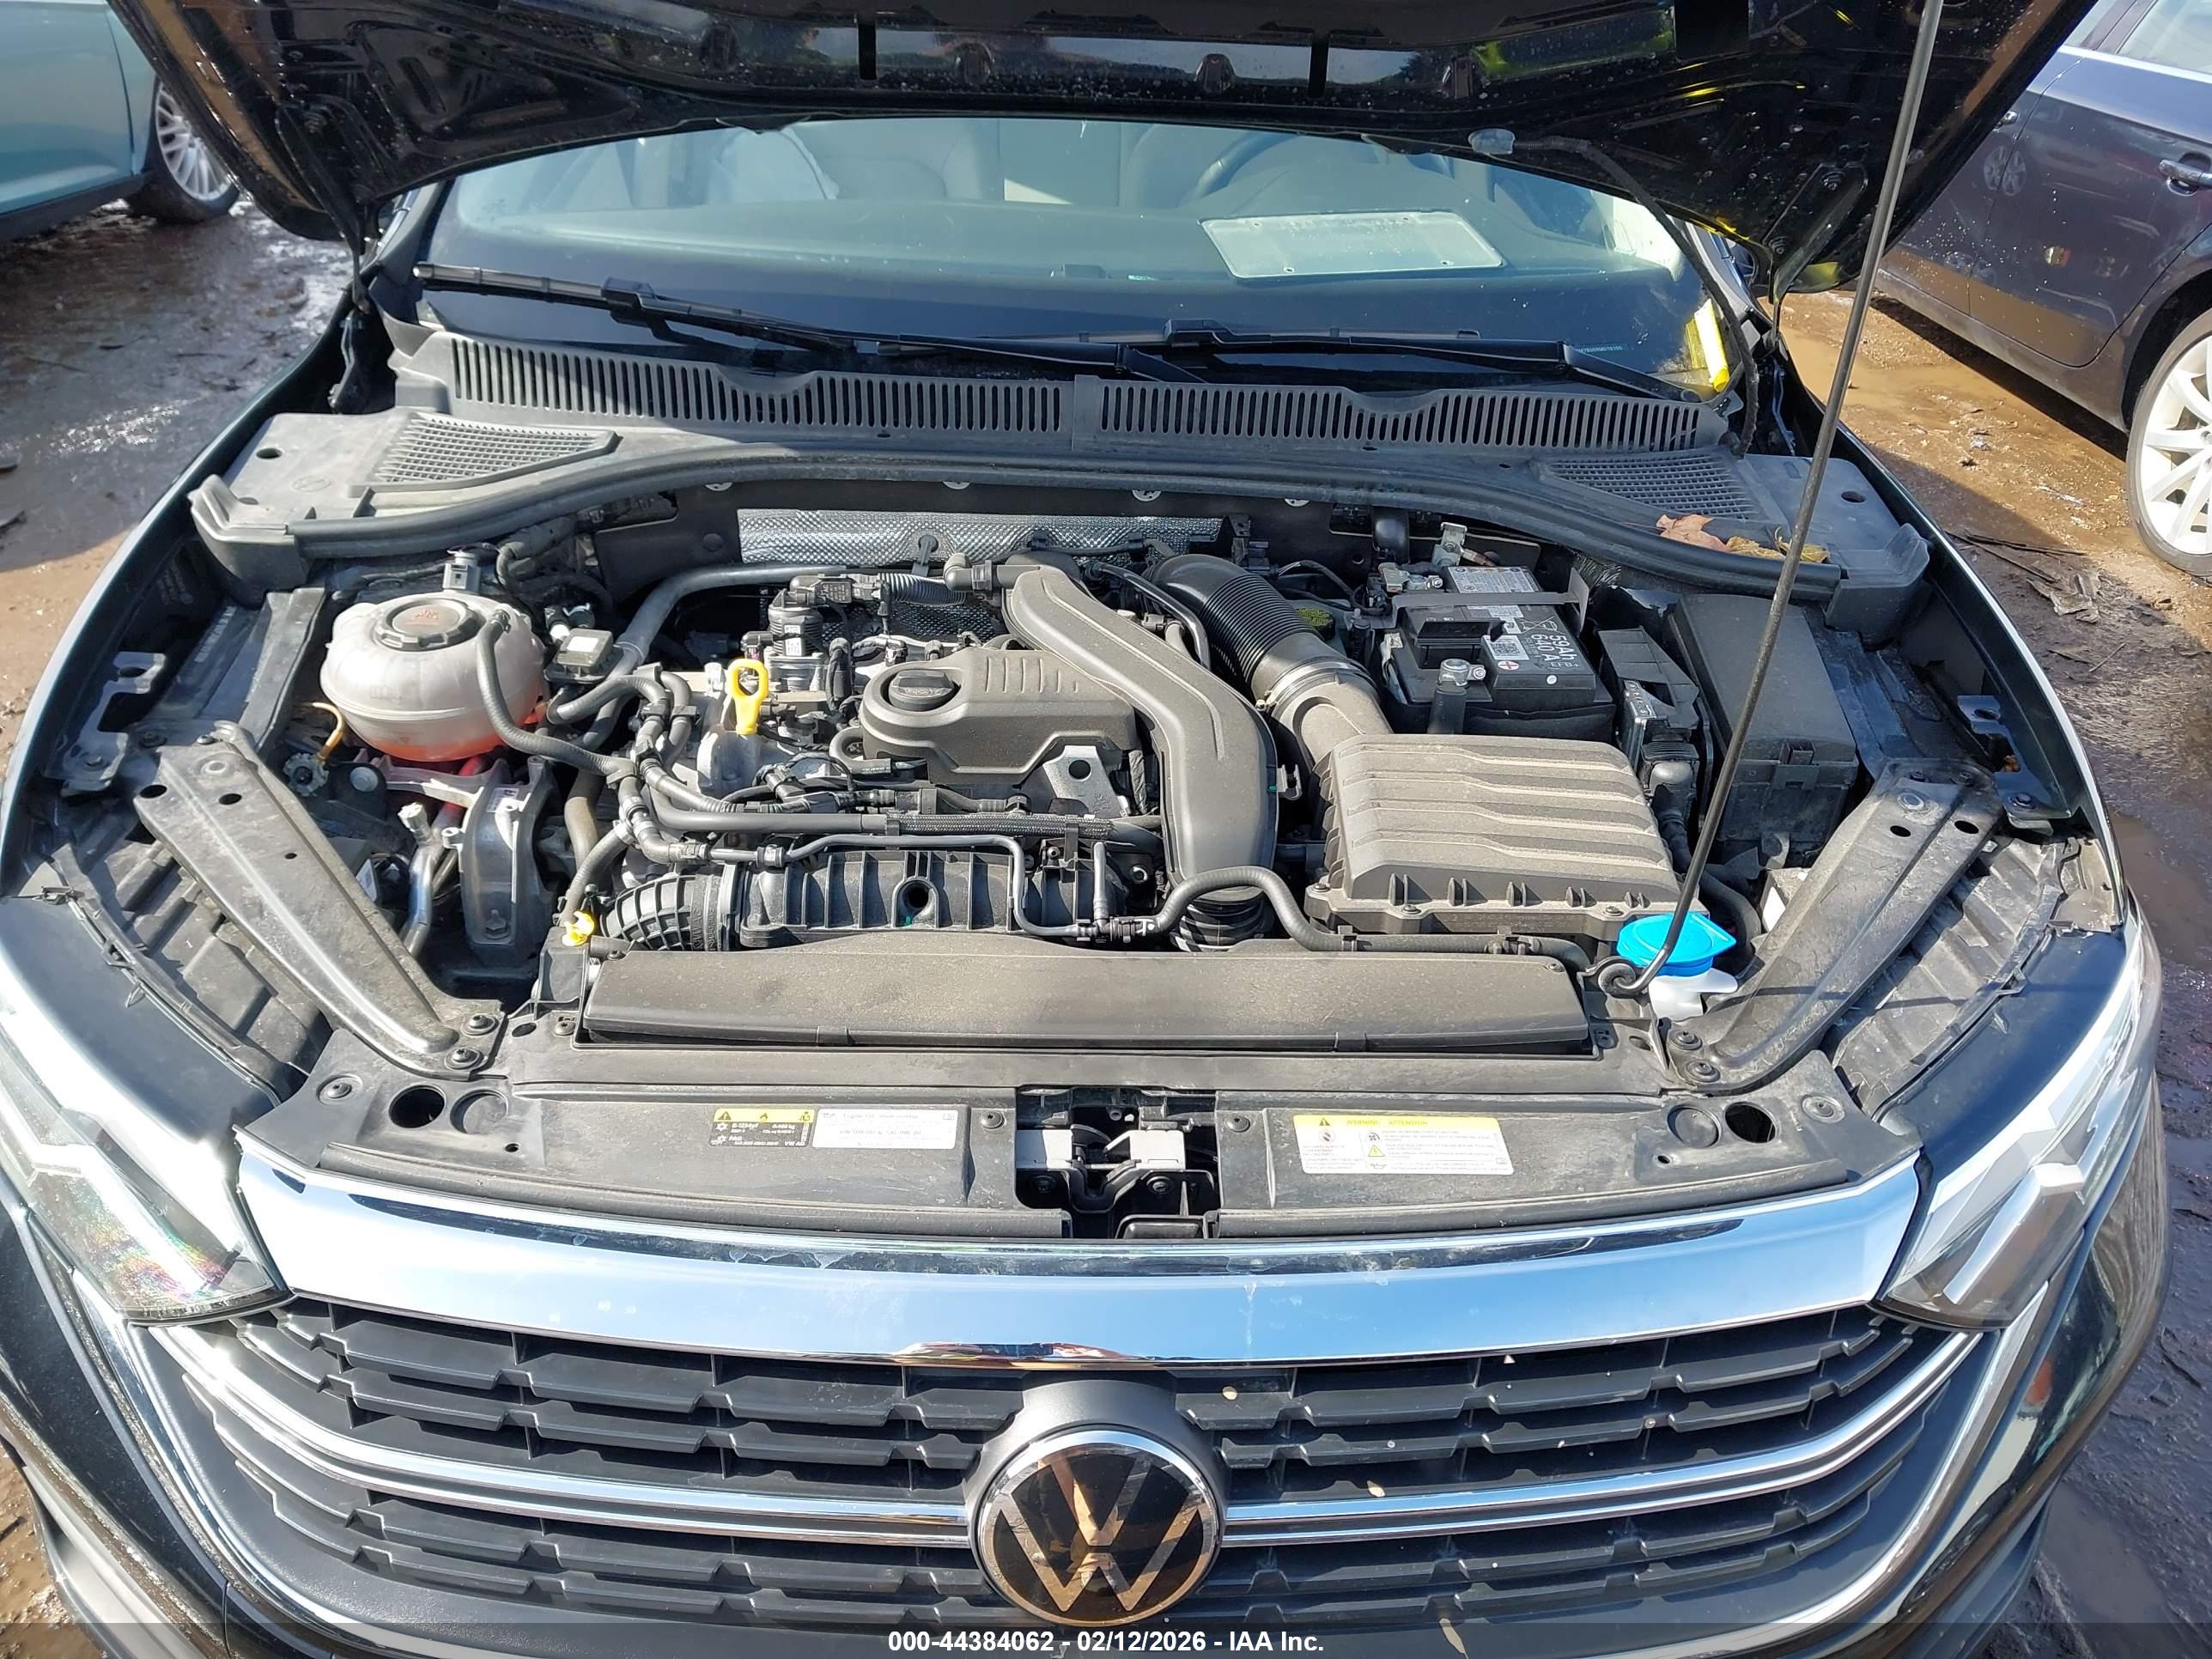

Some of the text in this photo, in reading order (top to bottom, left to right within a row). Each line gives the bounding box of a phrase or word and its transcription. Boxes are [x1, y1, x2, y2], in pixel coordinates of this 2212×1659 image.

[1531, 634, 1555, 652] 640
[1549, 635, 1578, 661] 59Ah
[1541, 653, 1561, 662] A
